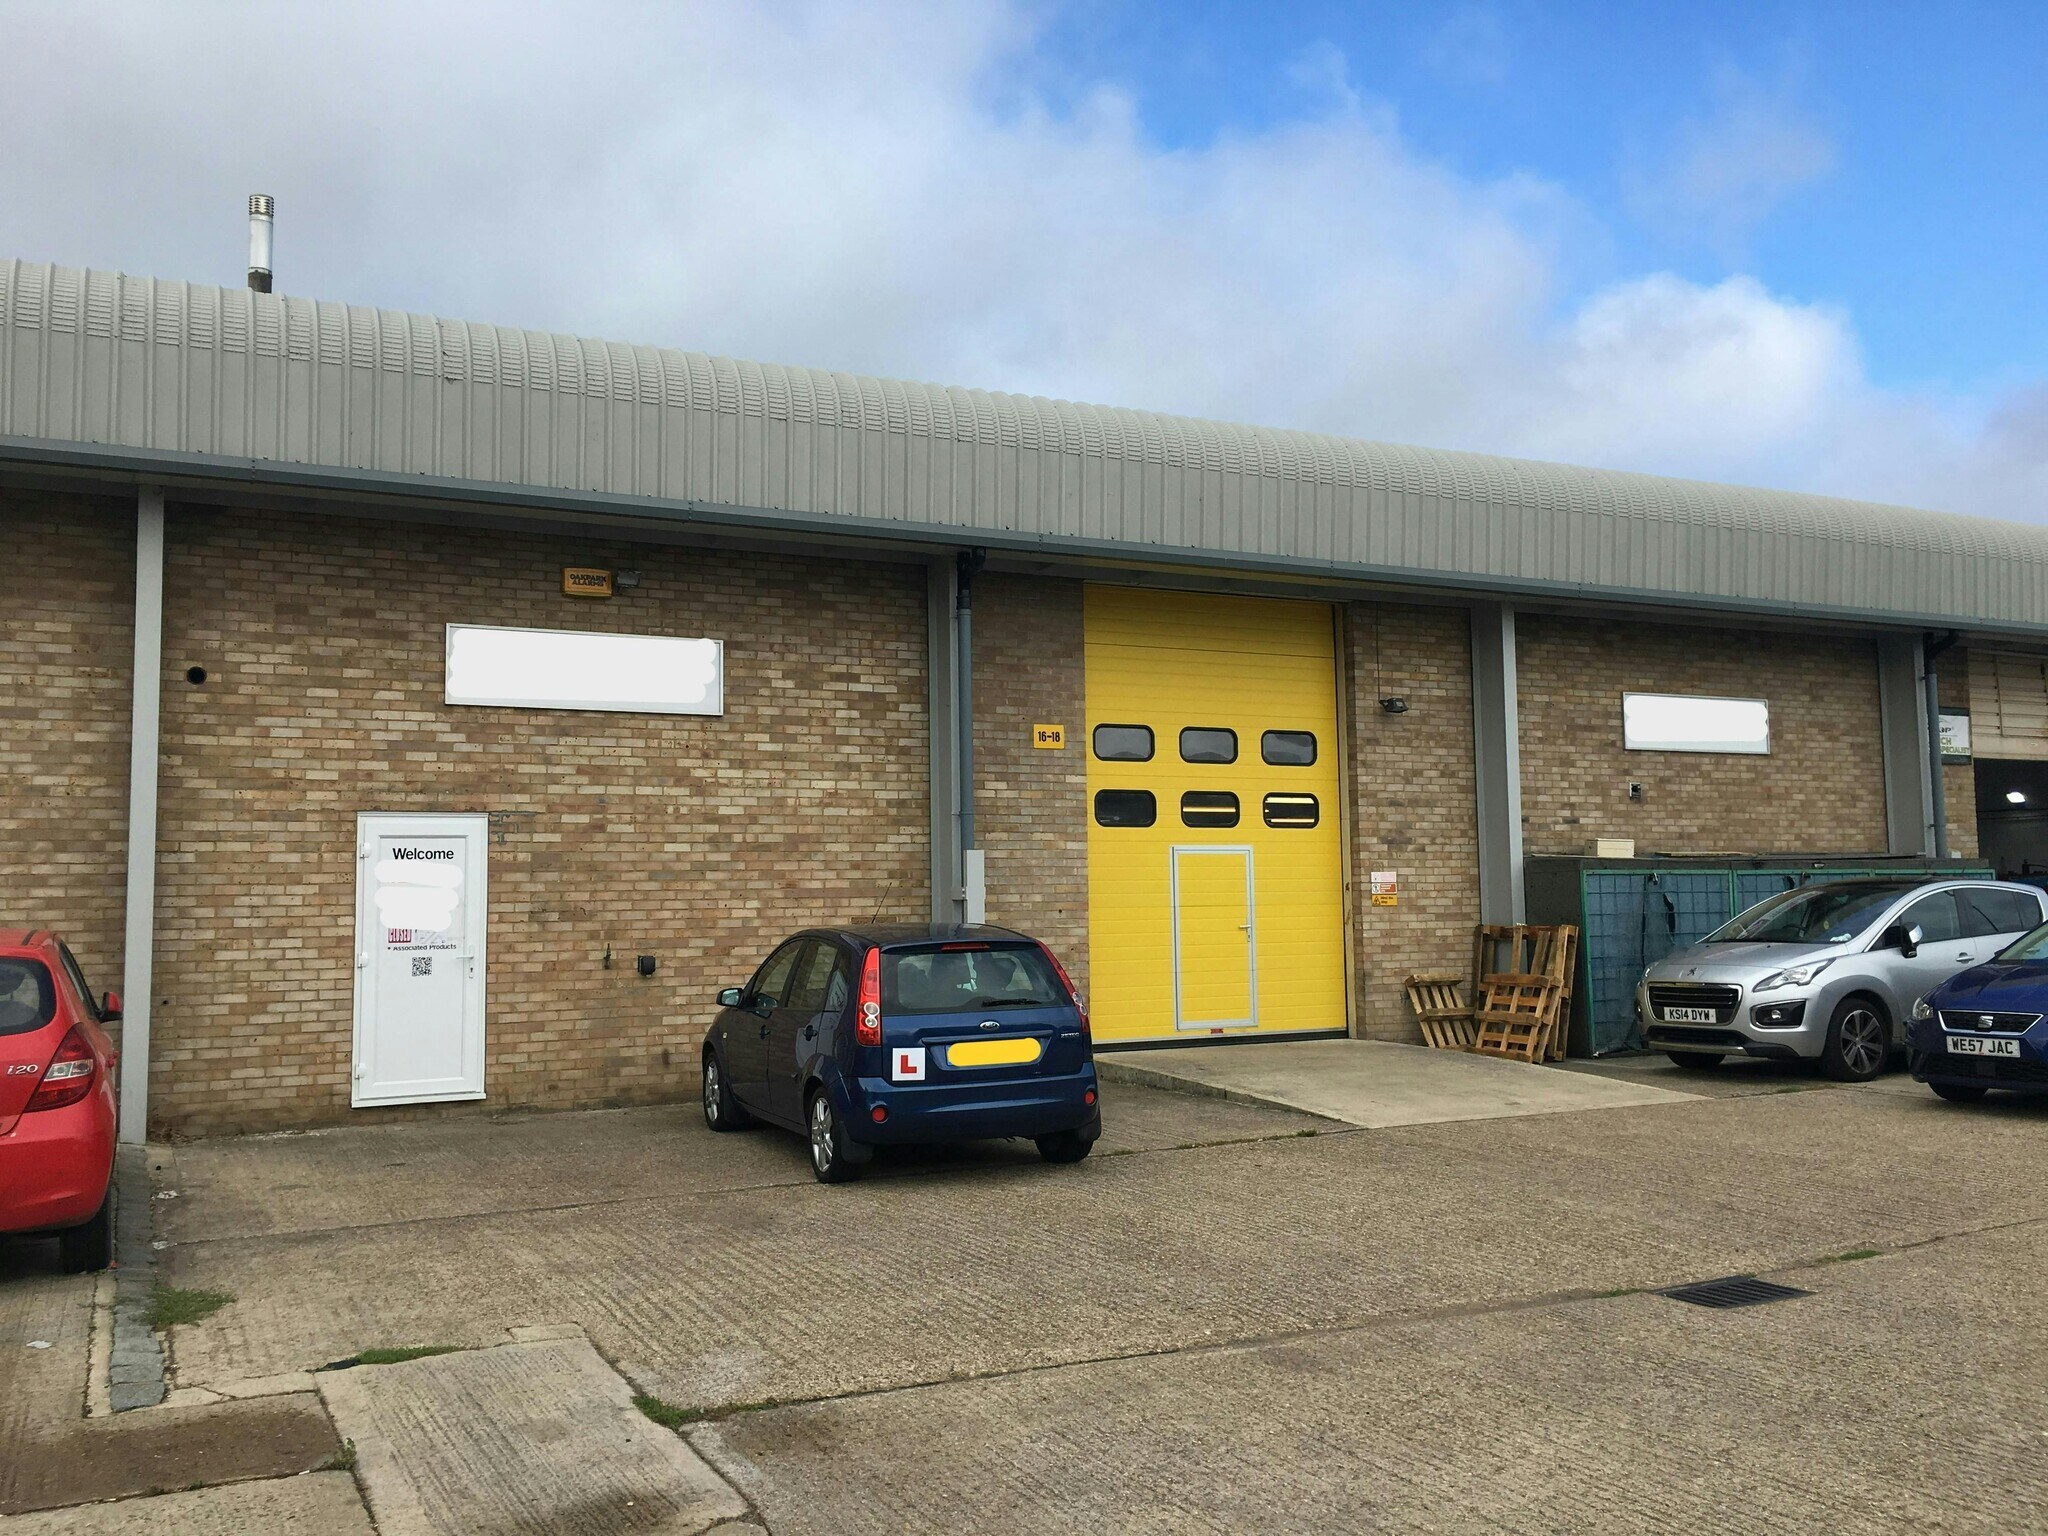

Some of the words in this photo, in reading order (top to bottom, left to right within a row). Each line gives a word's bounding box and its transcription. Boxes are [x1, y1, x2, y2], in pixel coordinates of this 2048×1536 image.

[569, 573, 607, 582] OAKPARK
[1038, 731, 1060, 742] 16-18
[392, 847, 454, 860] Welcome
[1669, 1009, 1689, 1020] KS14
[1691, 1009, 1710, 1021] DYW
[1951, 1038, 1984, 1052] WE57
[1988, 1041, 2014, 1054] JAC
[7, 1064, 38, 1075] i20
[900, 1055, 917, 1074] L
